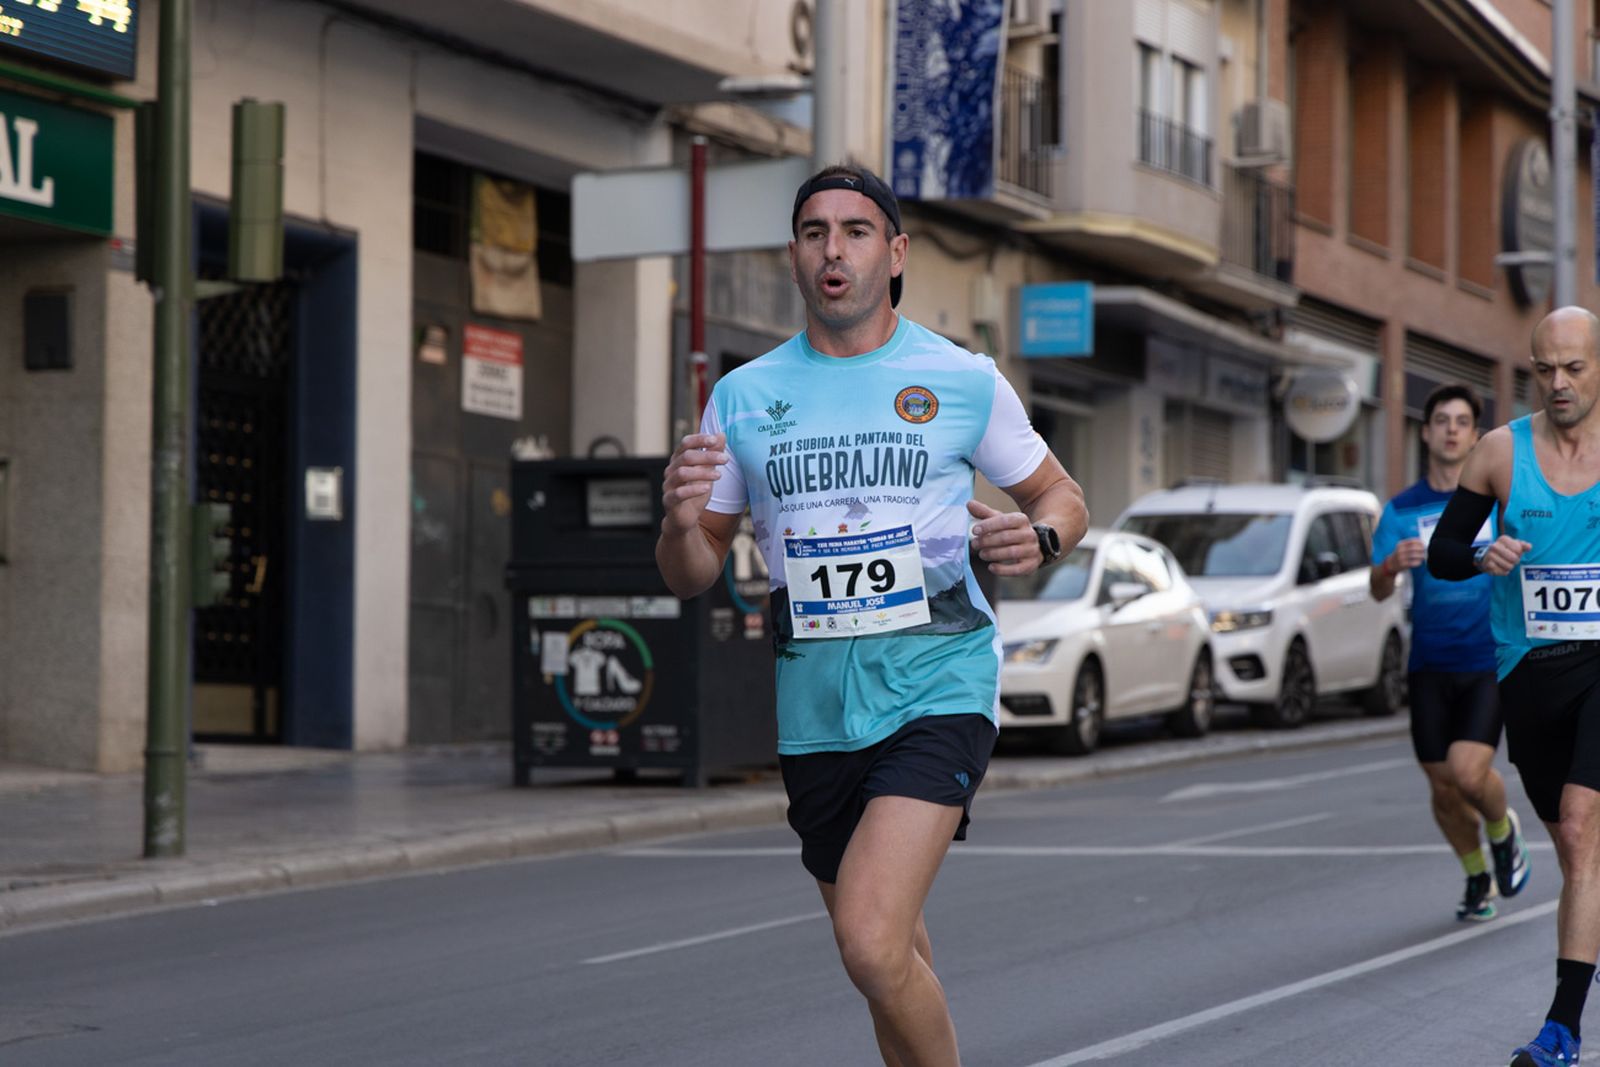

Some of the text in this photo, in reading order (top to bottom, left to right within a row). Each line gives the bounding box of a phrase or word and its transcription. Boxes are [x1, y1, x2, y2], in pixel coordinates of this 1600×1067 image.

[769, 432, 925, 457] XXI SUBIDA AL PANTANO DEL
[765, 447, 929, 502] QUIEBRAJANO
[790, 503, 805, 512] QUE
[806, 501, 823, 510] UNA
[863, 496, 881, 504] UNA
[882, 495, 920, 505] TRADICIÓN
[811, 559, 896, 599] 179
[827, 600, 863, 611] MANUEL
[866, 596, 885, 607] JOSÉ
[1534, 586, 1600, 611] 107
[1528, 642, 1582, 660] COMBAT
